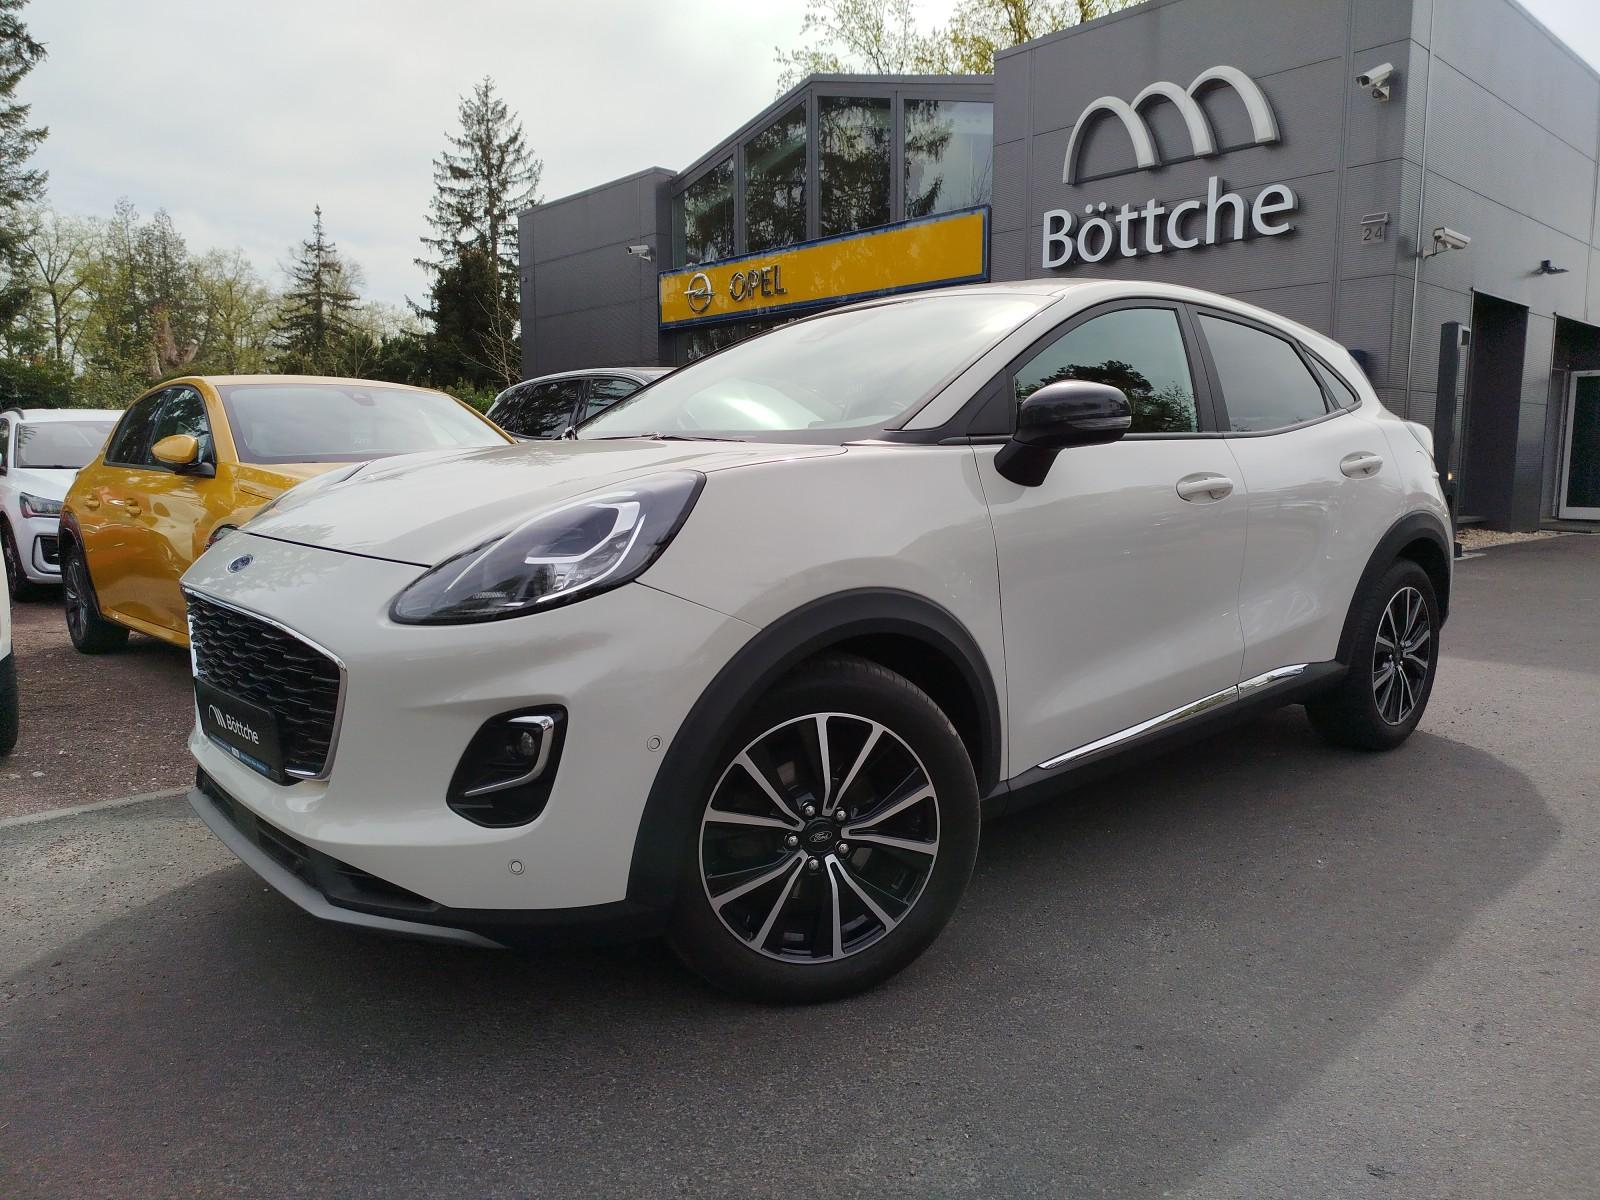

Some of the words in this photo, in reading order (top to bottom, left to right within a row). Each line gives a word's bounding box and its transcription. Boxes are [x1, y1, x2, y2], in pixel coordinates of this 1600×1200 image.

[1042, 175, 1297, 269] Böttche
[1363, 226, 1382, 241] 24
[728, 265, 787, 301] OPEL
[225, 713, 260, 745] Böttche
